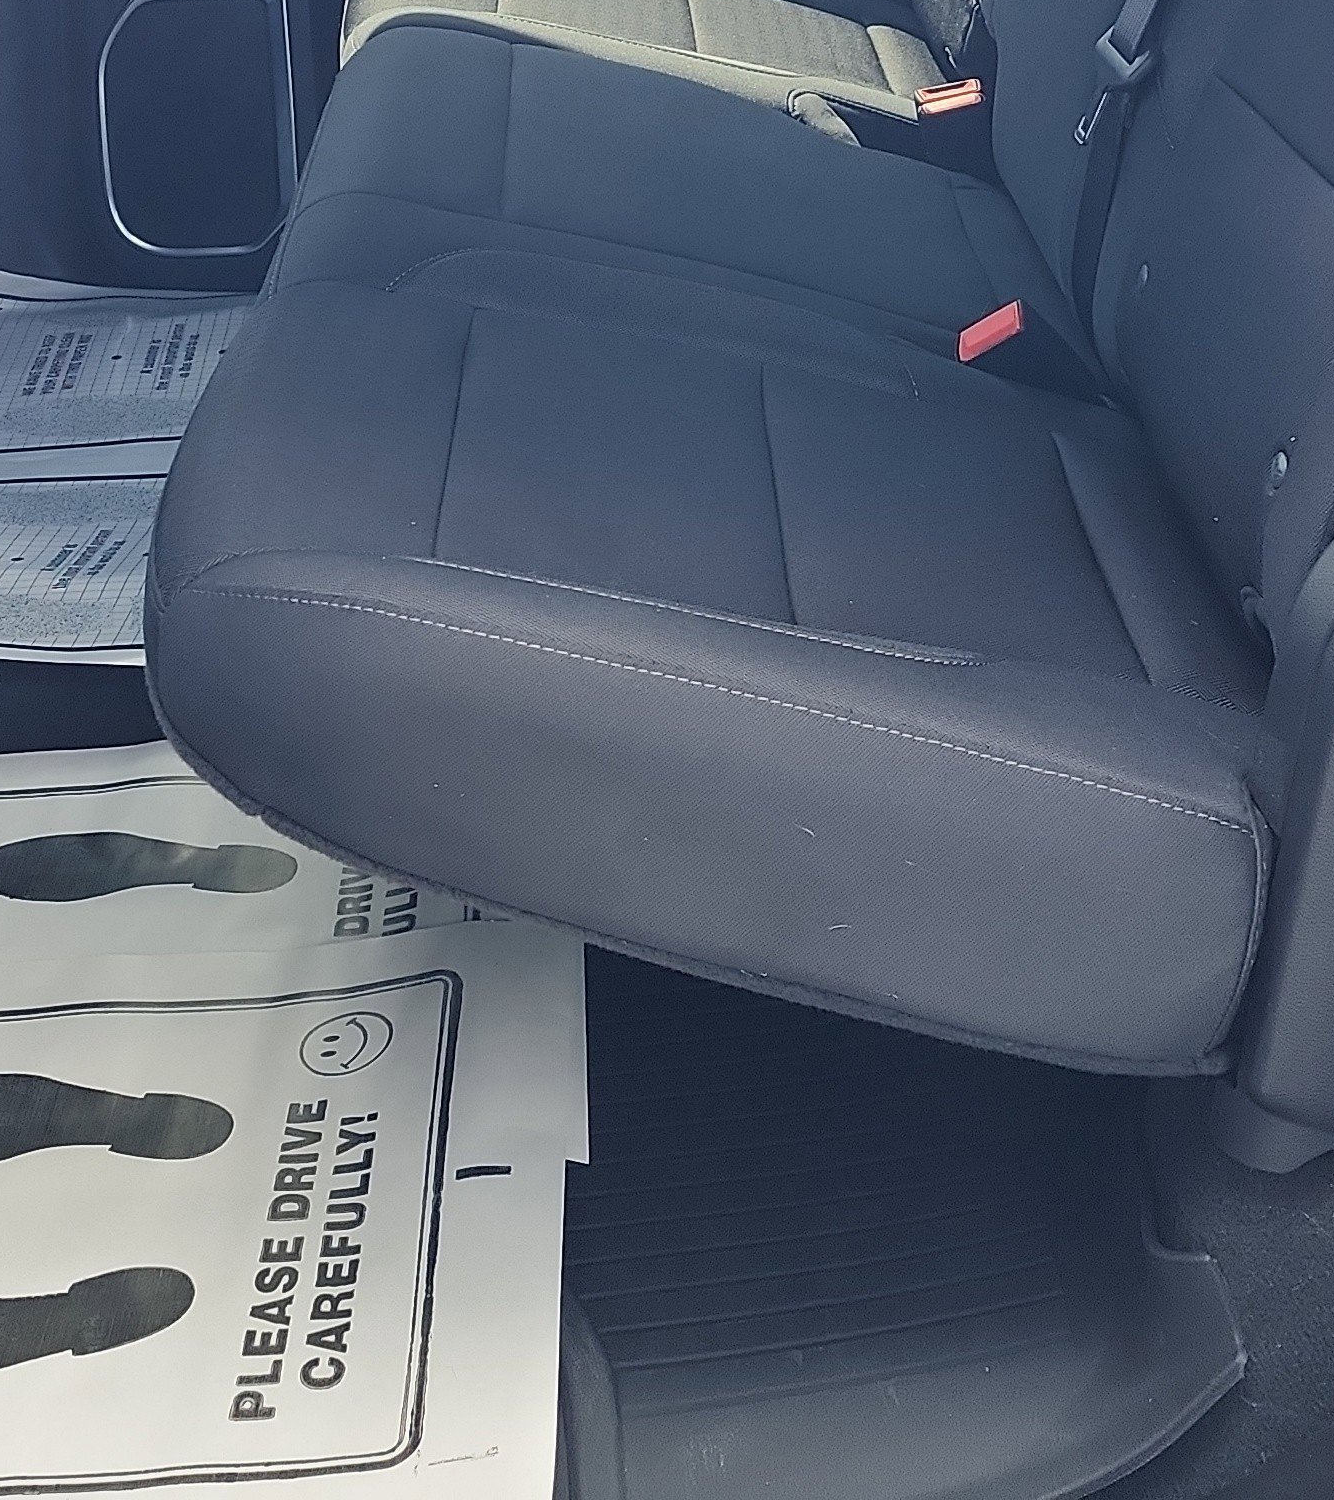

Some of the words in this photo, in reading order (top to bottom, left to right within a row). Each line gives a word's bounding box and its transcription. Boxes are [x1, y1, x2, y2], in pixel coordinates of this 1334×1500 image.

[333, 866, 374, 937] DRIV
[228, 1235, 305, 1422] PLEASE
[267, 1099, 328, 1222] DRIVE
[299, 1111, 379, 1391] CAREFULLY!
